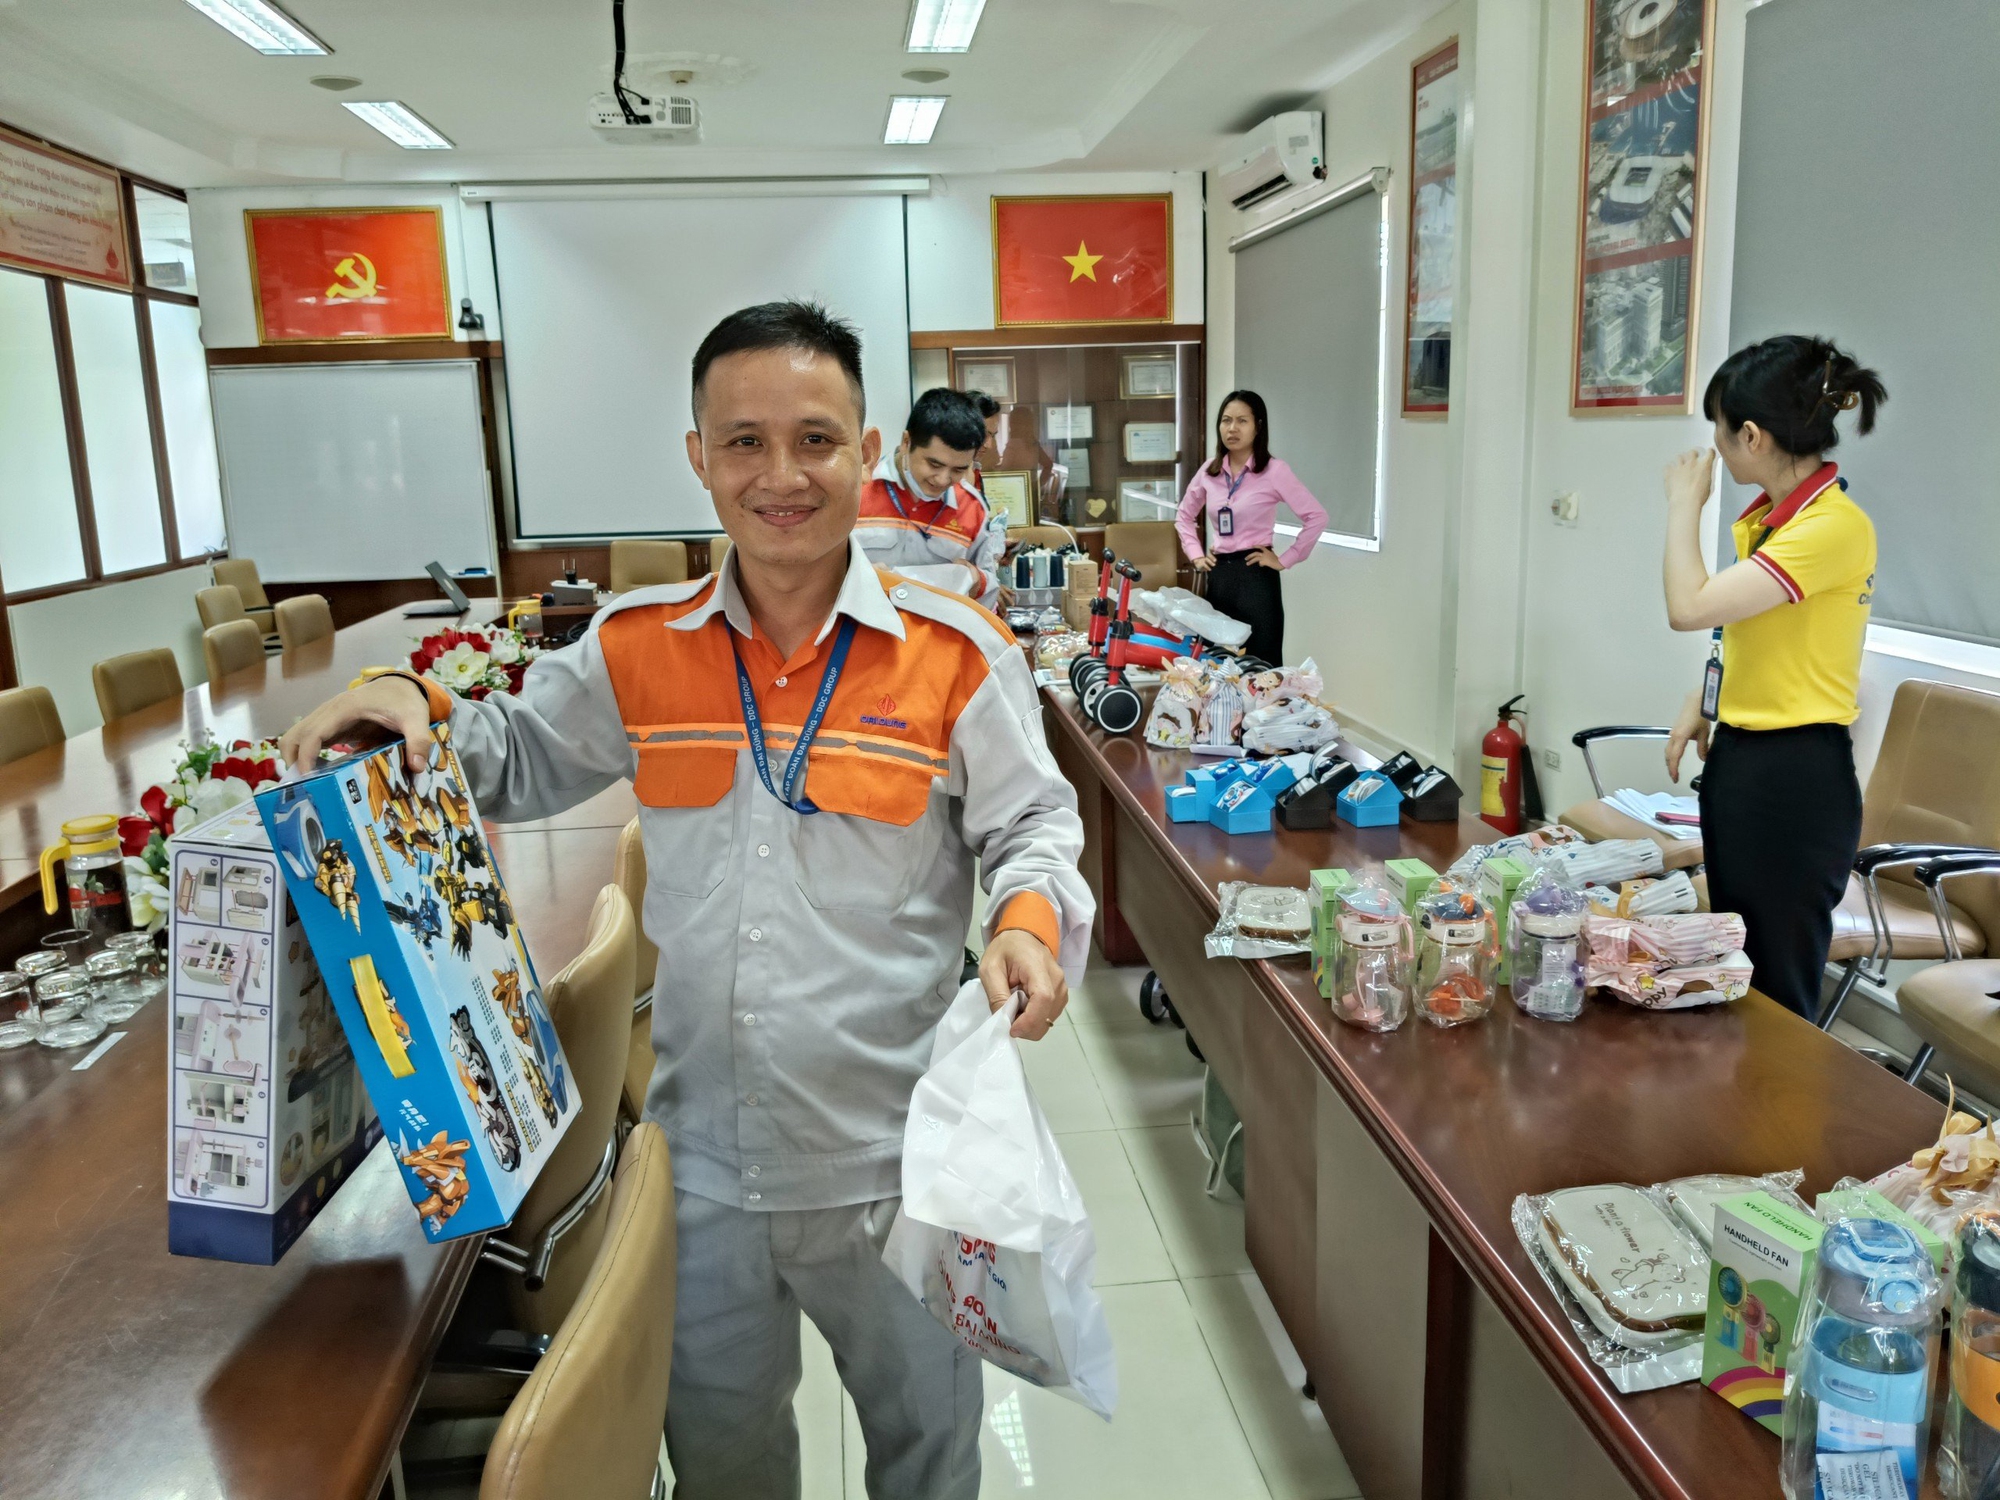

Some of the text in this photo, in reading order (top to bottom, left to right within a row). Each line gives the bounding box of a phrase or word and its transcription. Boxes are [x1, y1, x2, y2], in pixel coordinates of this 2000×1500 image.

[741, 676, 752, 702] GROUP
[816, 696, 828, 713] DDC
[824, 667, 837, 695] GROUP
[746, 704, 756, 721] DDC
[1602, 1203, 1621, 1220] Plant
[1620, 1227, 1640, 1253] flower
[1744, 1201, 1813, 1241] HANDHELD FAN
[1724, 1224, 1789, 1267] HANDHELD FAN
[1862, 1464, 1871, 1481] GEL
